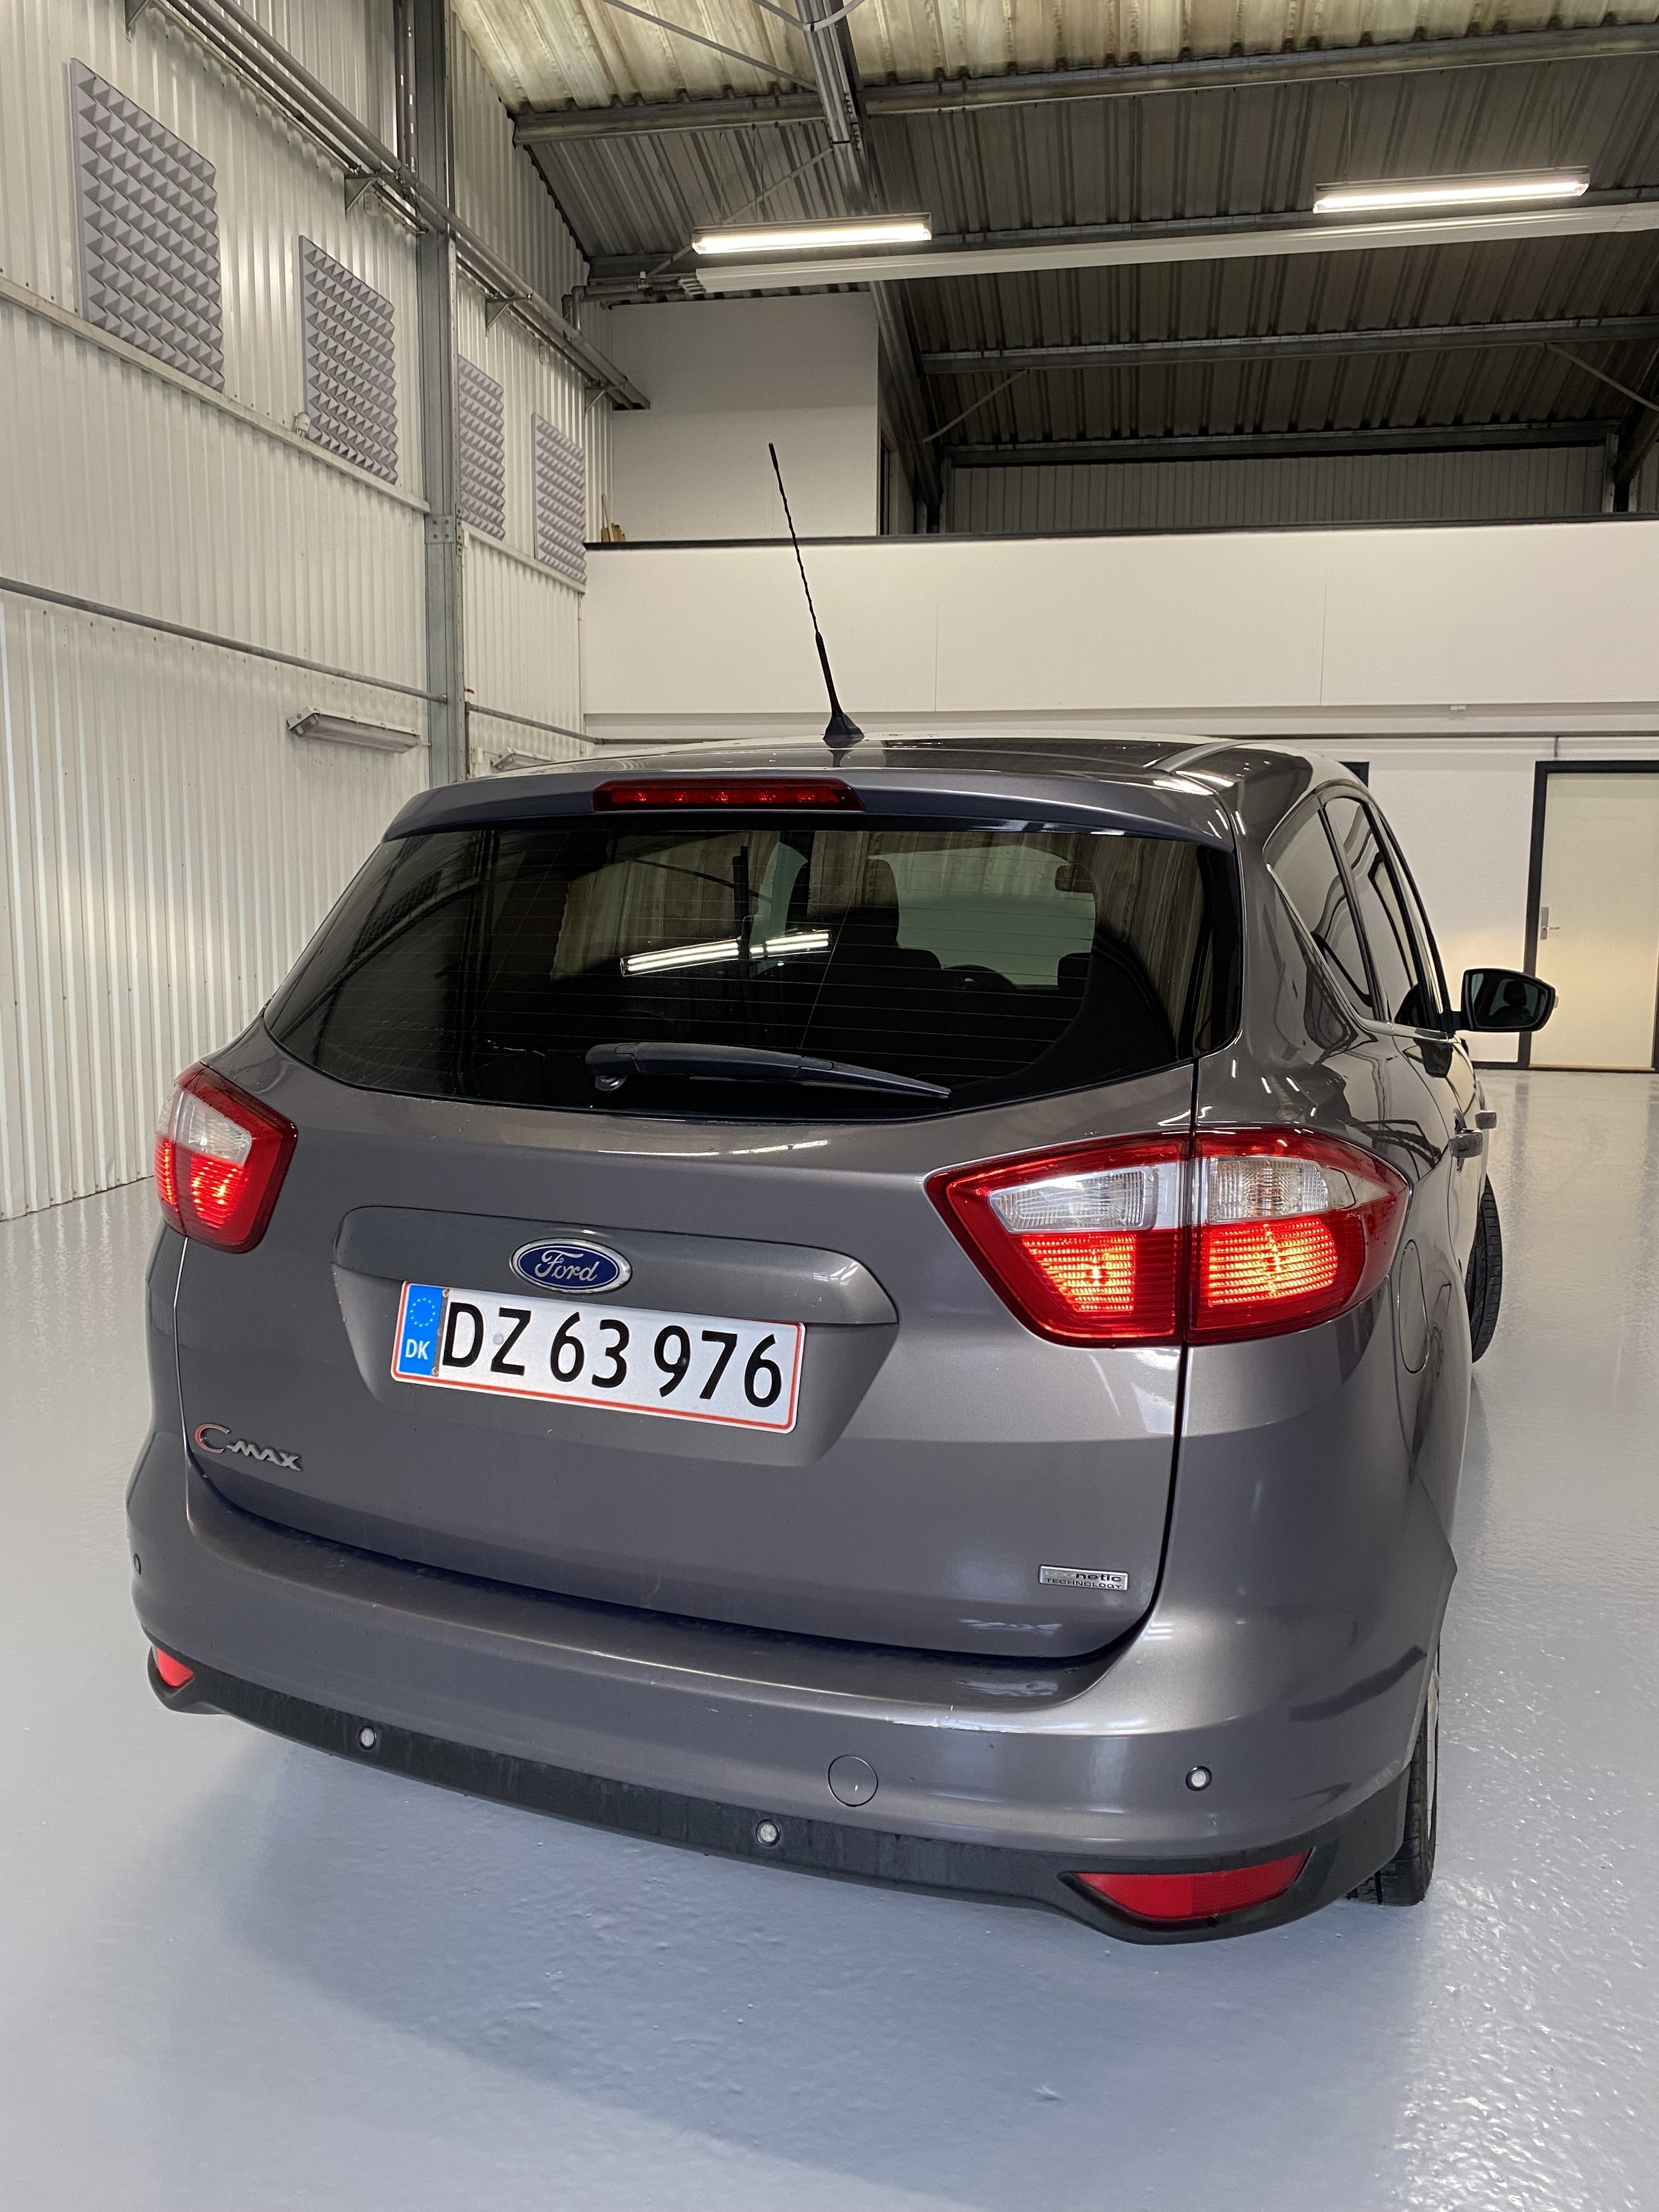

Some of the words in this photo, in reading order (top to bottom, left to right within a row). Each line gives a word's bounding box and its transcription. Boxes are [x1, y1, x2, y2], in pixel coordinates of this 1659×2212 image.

[534, 1250, 600, 1282] Ford
[405, 1338, 430, 1360] DK
[442, 1301, 532, 1376] DZ
[550, 1312, 630, 1388] 63
[654, 1325, 782, 1408] 976
[1046, 1578, 1122, 1589] TECHNOLOGY
